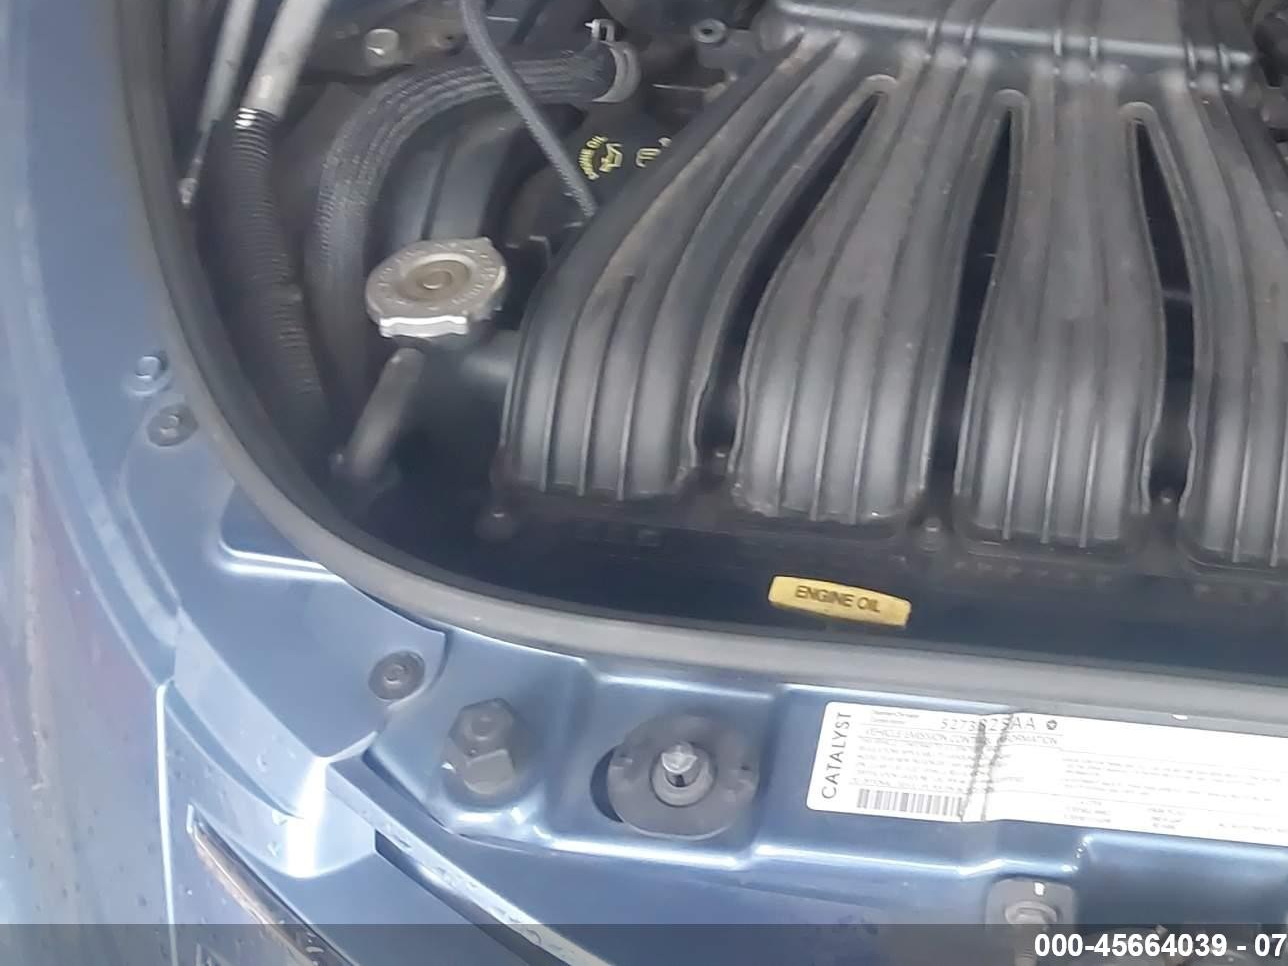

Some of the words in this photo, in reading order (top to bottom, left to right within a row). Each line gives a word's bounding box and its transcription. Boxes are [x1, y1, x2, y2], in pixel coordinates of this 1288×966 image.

[795, 585, 855, 607] ENGINE
[856, 597, 880, 613] OIL
[821, 712, 851, 800] CATALYST
